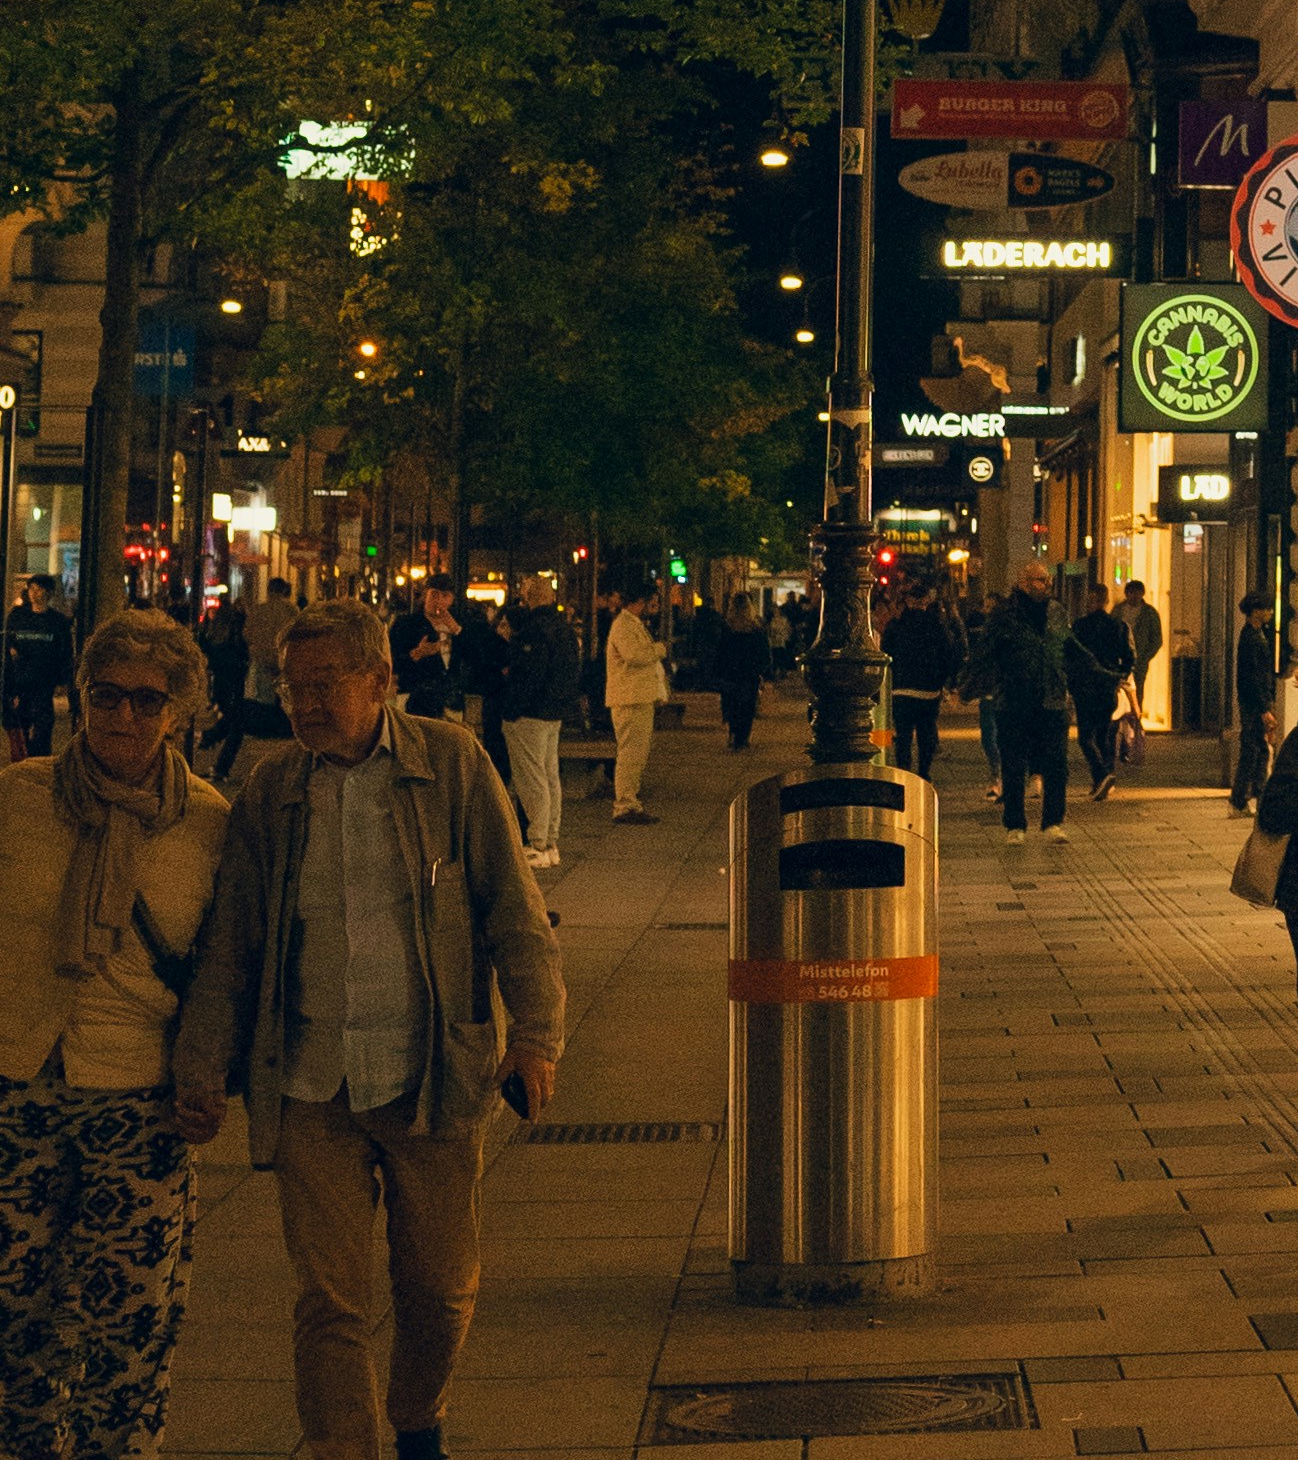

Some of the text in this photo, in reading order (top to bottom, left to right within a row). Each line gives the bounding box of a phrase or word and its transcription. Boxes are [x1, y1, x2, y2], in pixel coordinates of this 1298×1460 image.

[939, 96, 1067, 113] BURGER KING
[1147, 305, 1244, 348] CANNABIS
[1157, 382, 1233, 411] WORLD
[901, 413, 1006, 438] WAGNER
[799, 962, 889, 979] Misttelefon
[818, 984, 872, 999] 546 48
